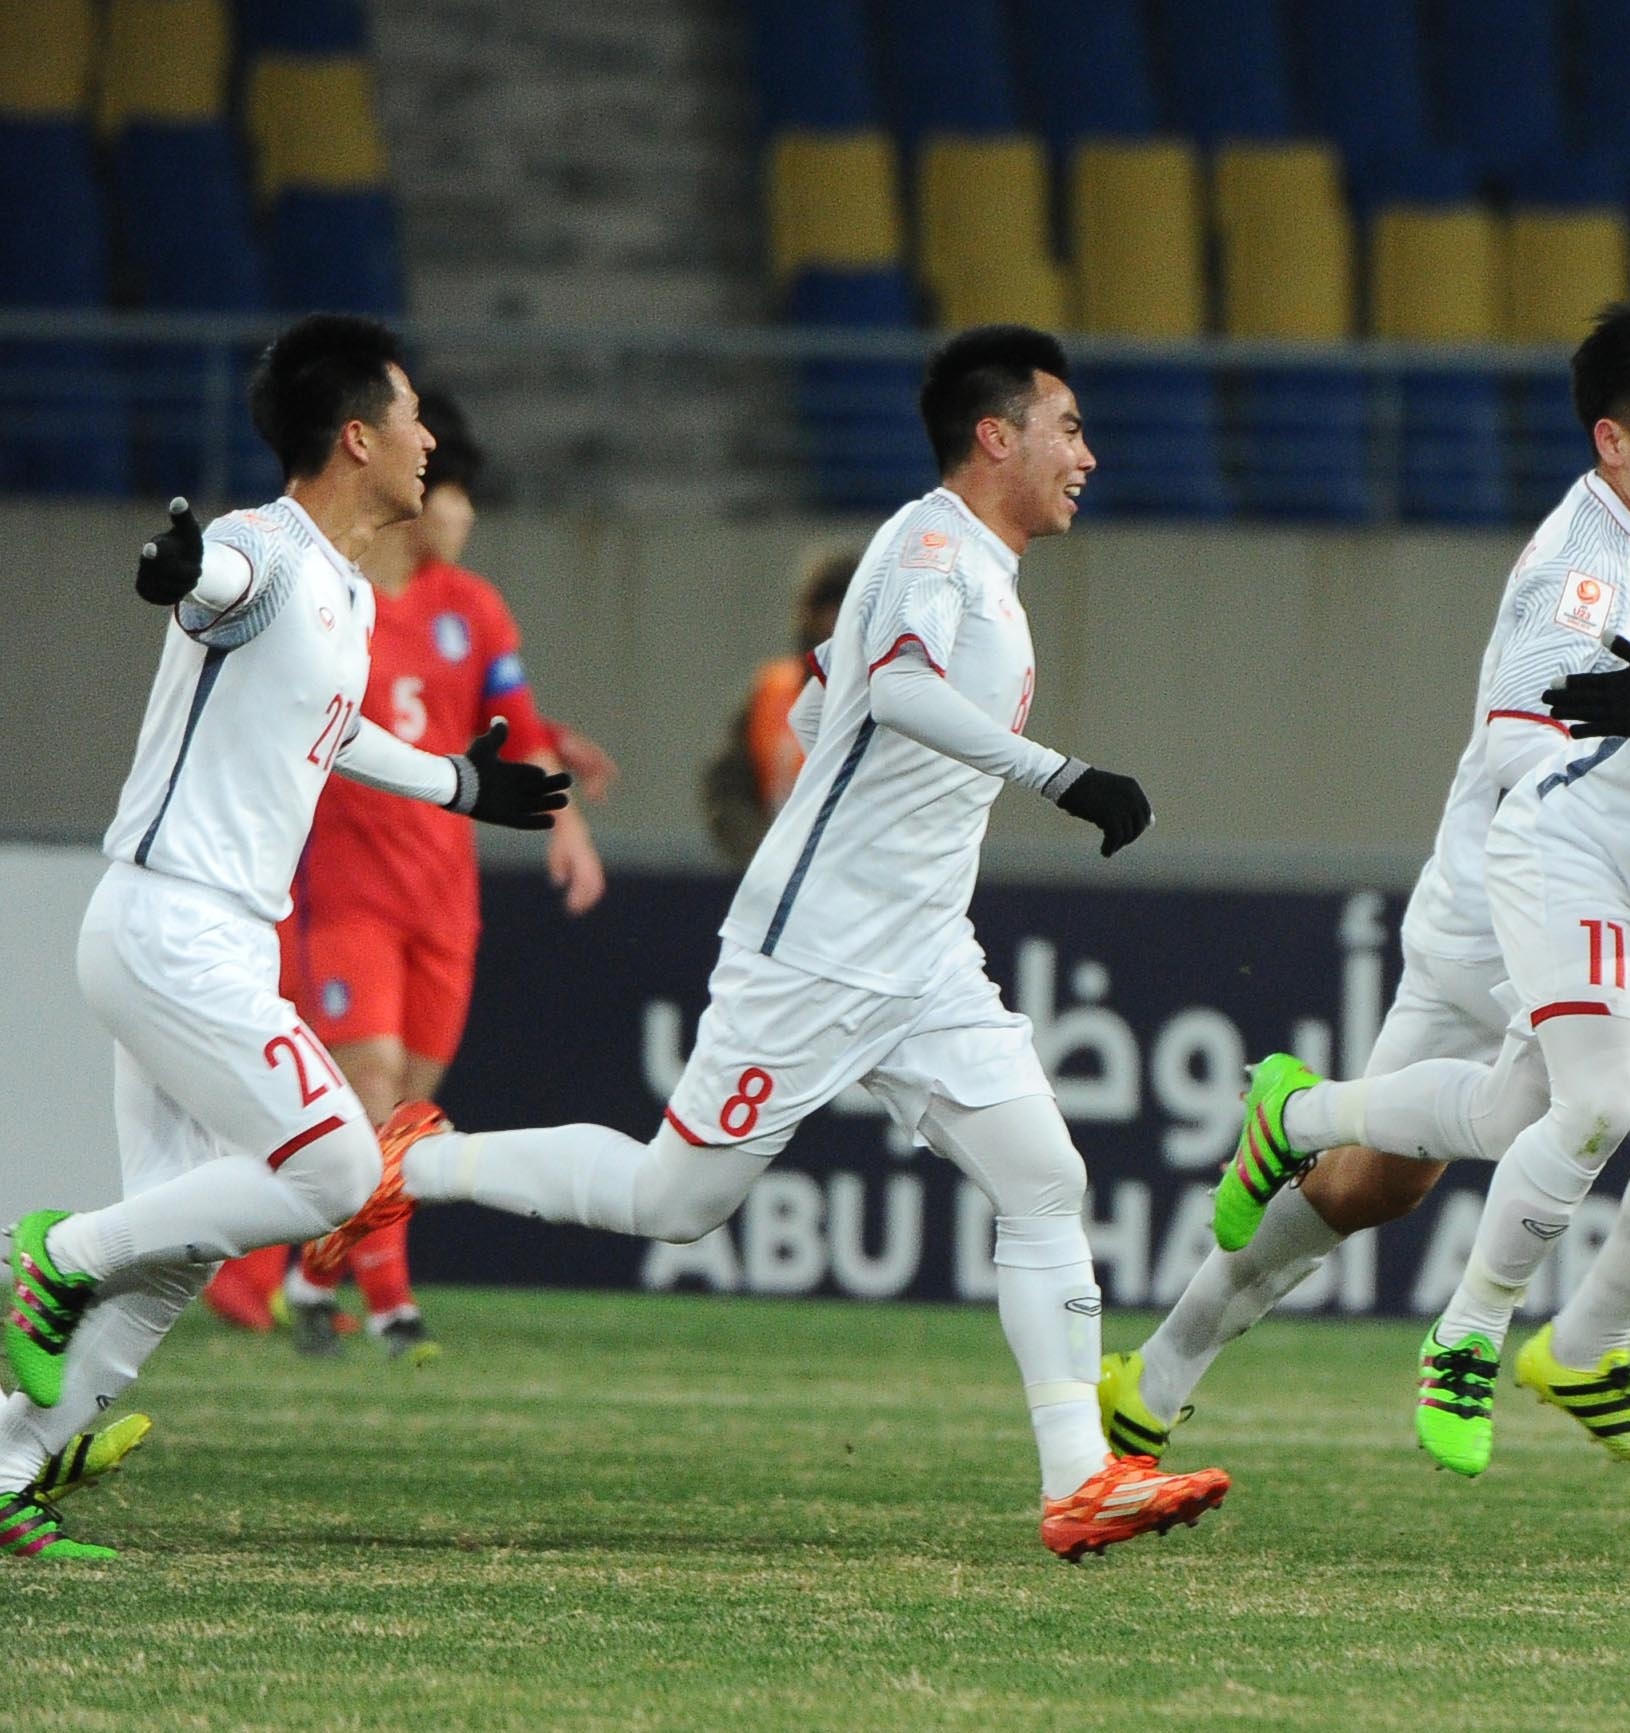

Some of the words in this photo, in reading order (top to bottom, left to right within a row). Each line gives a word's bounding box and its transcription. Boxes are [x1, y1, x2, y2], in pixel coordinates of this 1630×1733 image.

[307, 693, 354, 771] 21
[391, 676, 428, 744] 5
[1580, 919, 1626, 990] 11
[264, 1026, 344, 1108] 21
[719, 1067, 773, 1138] 8
[640, 1170, 926, 1298] ABU
